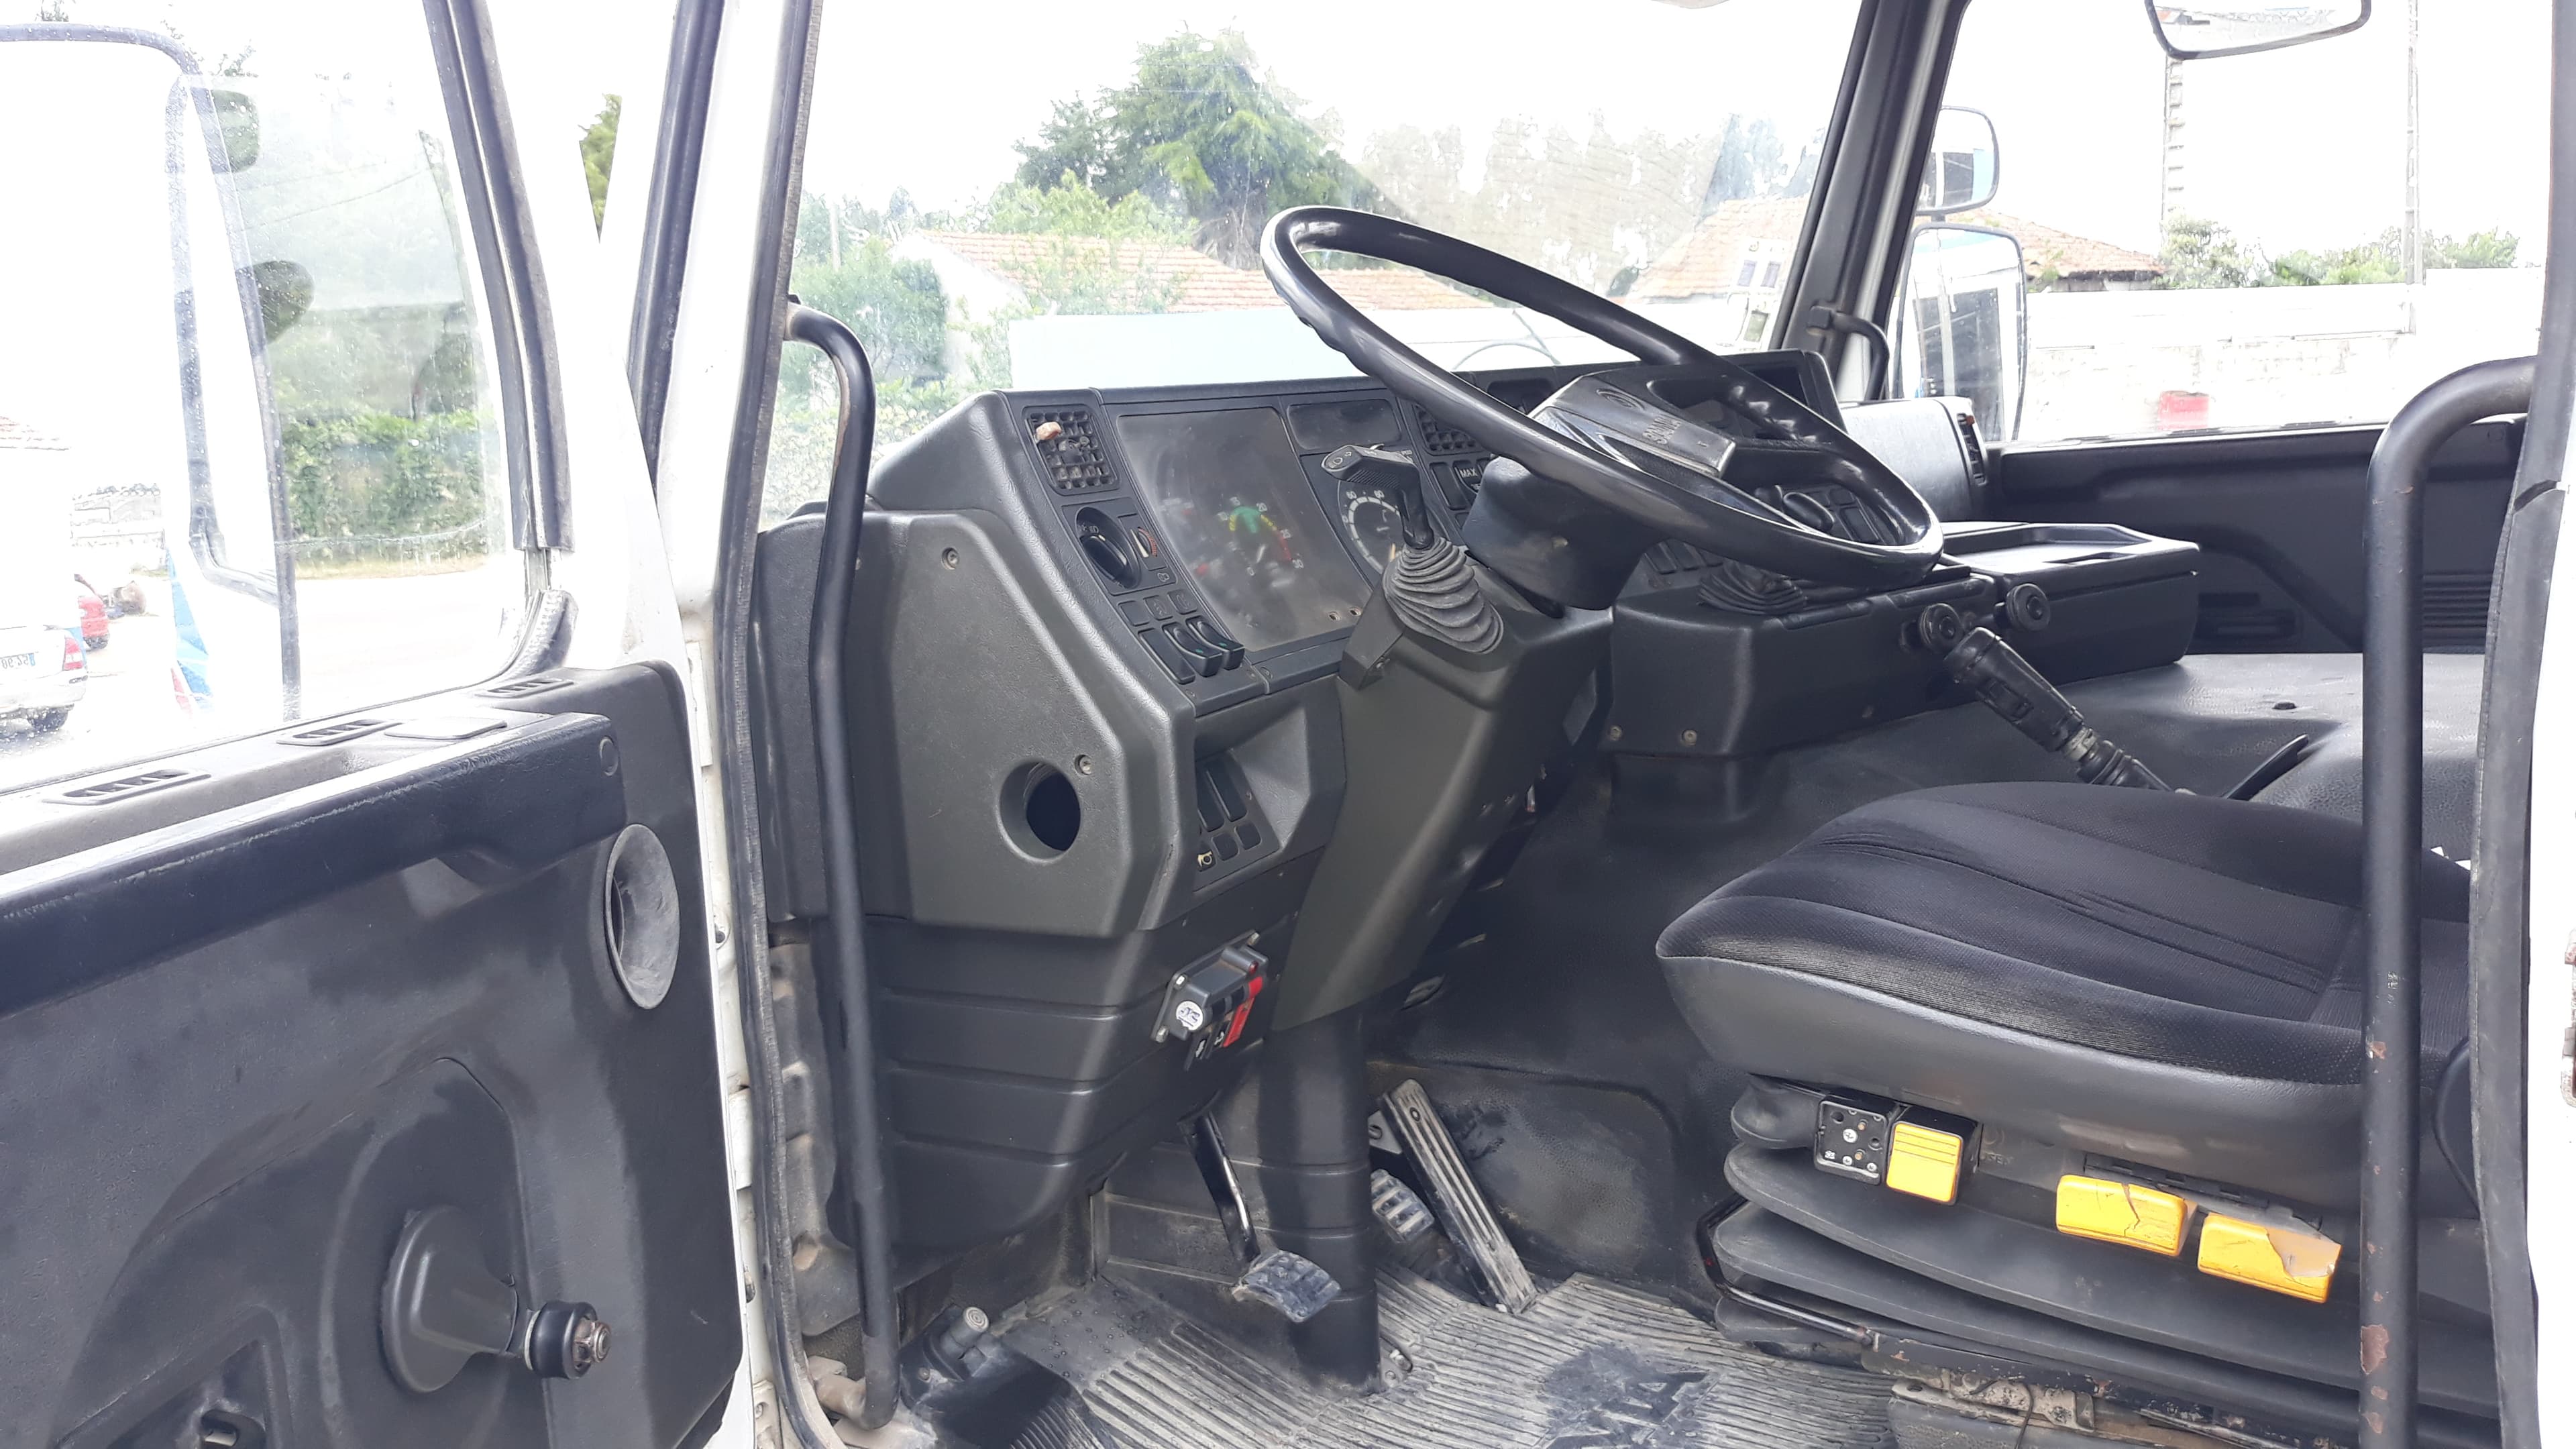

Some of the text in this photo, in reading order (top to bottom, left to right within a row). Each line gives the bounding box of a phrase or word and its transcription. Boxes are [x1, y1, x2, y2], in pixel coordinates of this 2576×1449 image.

[1459, 468, 1479, 479] MAX
[1256, 502, 1267, 513] 20
[1292, 558, 1304, 569] 30
